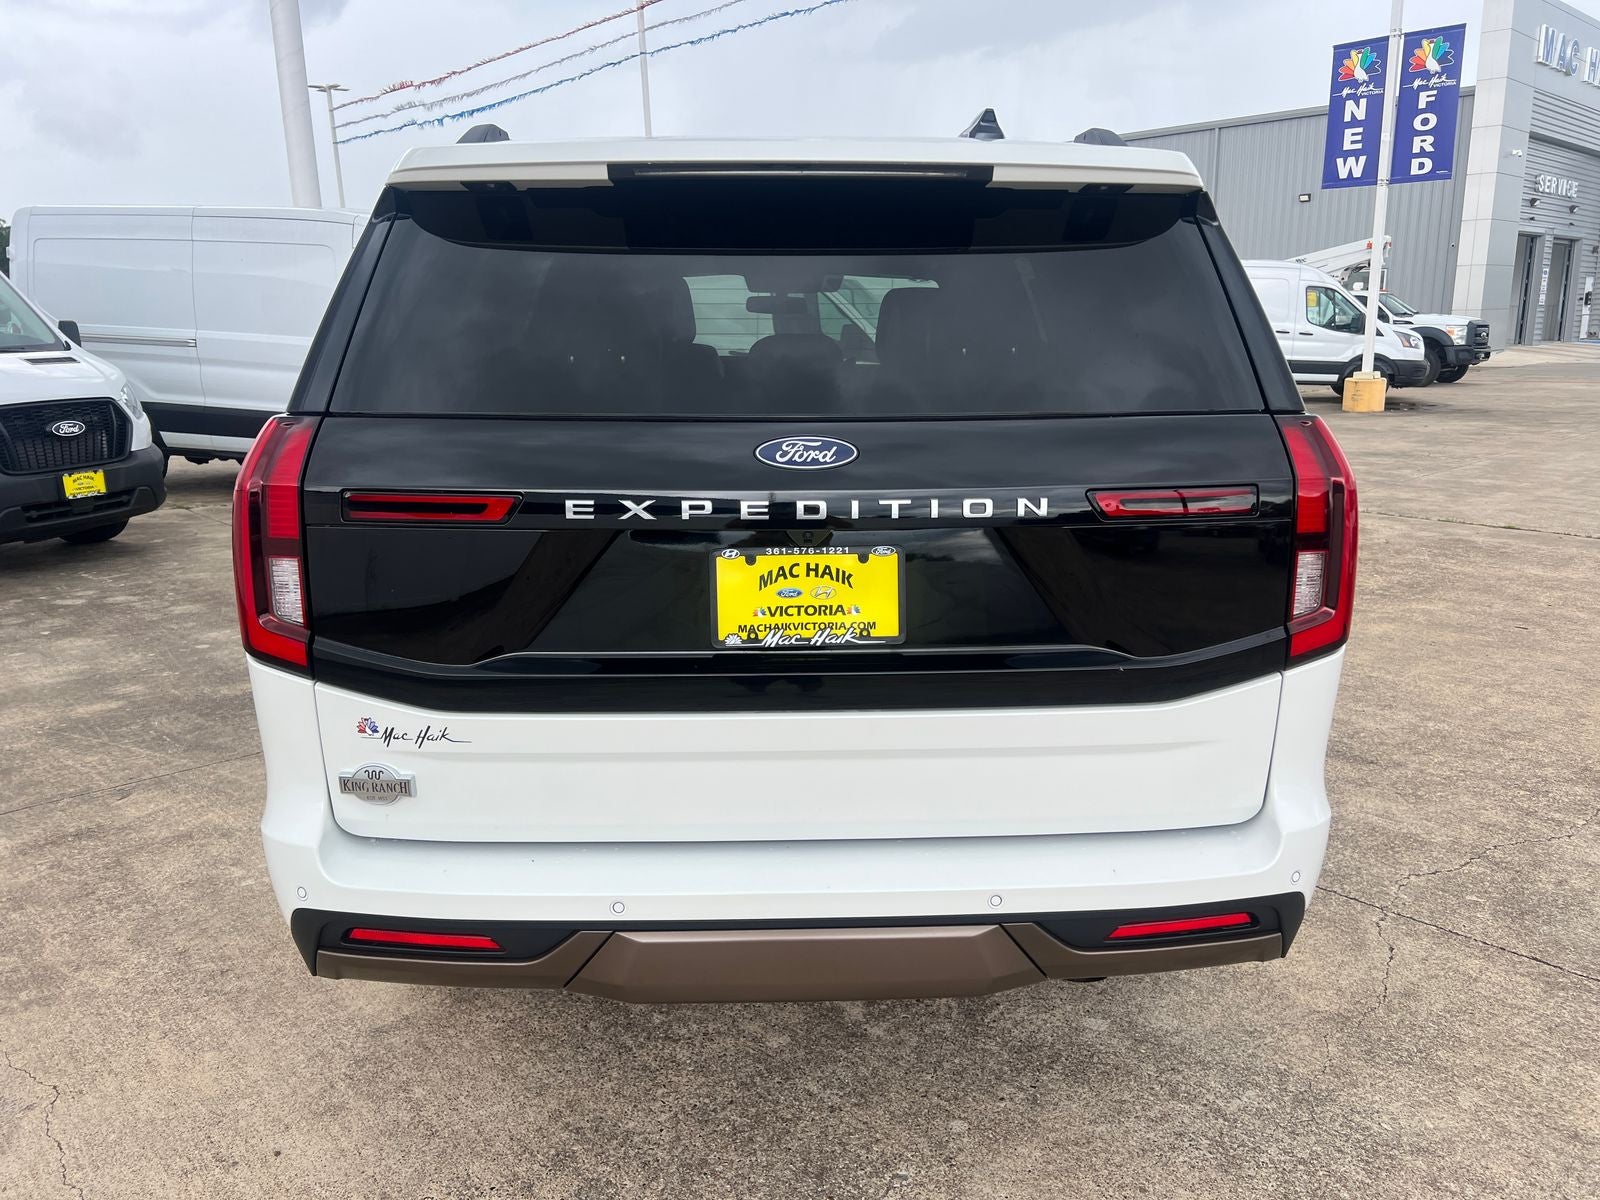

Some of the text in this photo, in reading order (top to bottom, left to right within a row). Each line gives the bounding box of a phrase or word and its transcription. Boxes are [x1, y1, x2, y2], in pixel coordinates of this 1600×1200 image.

[1538, 24, 1580, 76] MAC
[1336, 98, 1367, 179] NEW
[1411, 90, 1437, 176] FORD
[1537, 174, 1579, 198] SERVICE
[58, 423, 80, 434] Ford
[775, 440, 836, 463] Ford
[564, 496, 1050, 521] EXPEDITION
[765, 547, 850, 555] 361-576-1221
[758, 562, 854, 592] MAC HAIK
[780, 588, 799, 597] Ford
[767, 604, 847, 618] VICTORIA
[737, 621, 877, 634] MACHAIKVICTORIA.COM
[758, 627, 866, 648] Mac Haik
[377, 725, 461, 749] Mac Haik
[343, 779, 408, 794] KING RANCH
